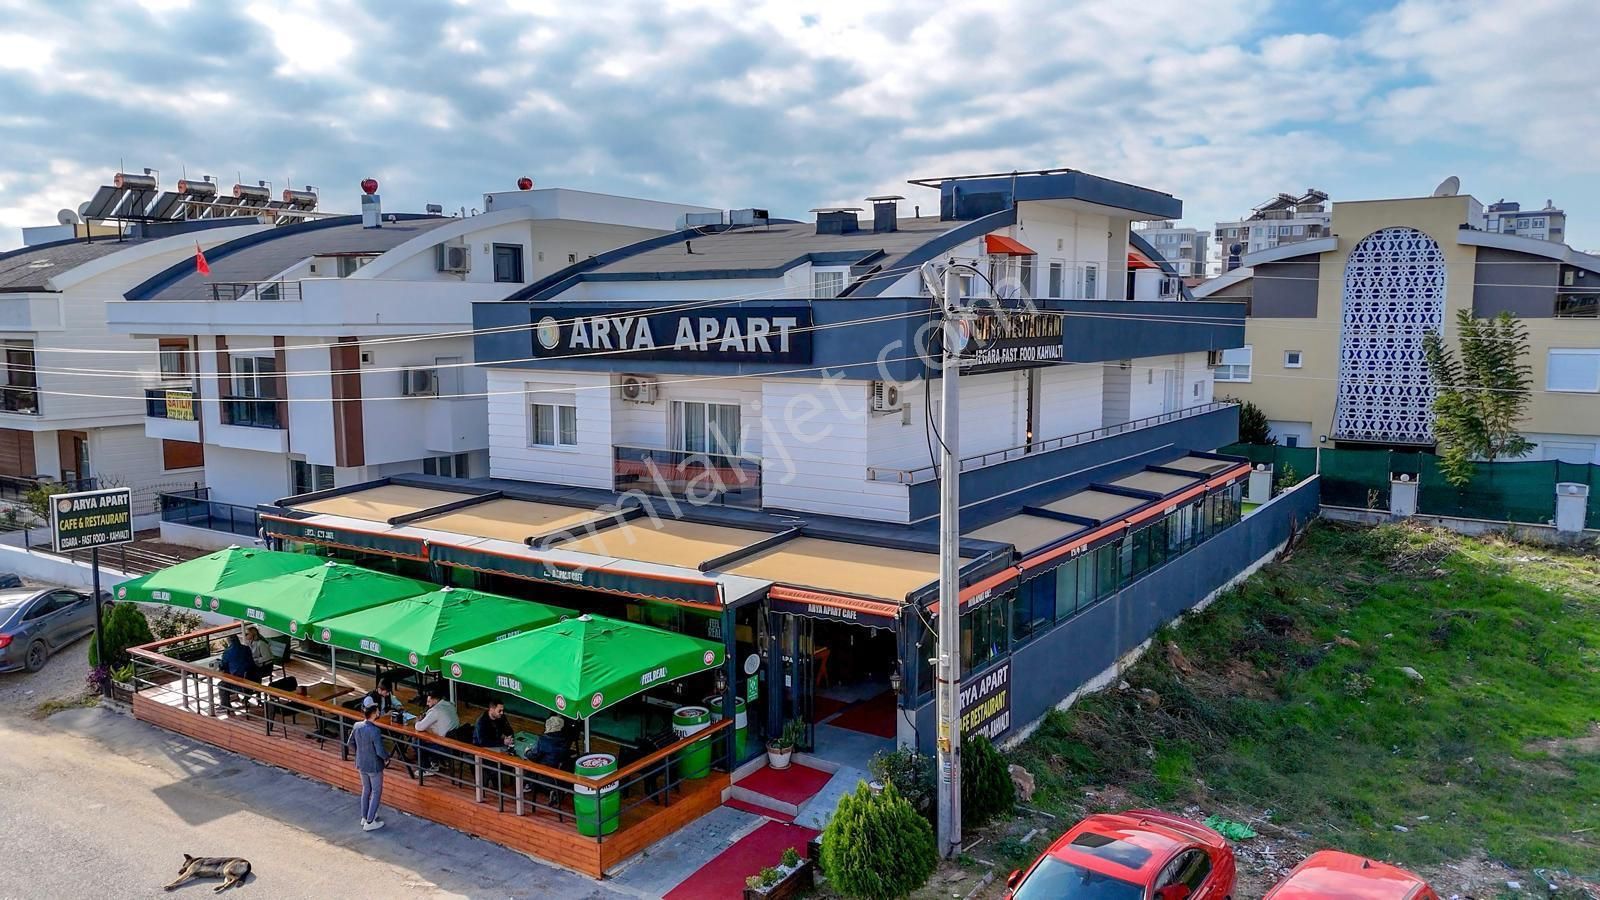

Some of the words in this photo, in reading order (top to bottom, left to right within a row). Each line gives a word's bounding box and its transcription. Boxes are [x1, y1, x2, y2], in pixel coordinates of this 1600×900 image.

[569, 317, 654, 350] ARYA
[673, 317, 797, 353] APART
[1002, 347, 1018, 364] FAST
[1019, 346, 1035, 361] FOOD
[1037, 345, 1063, 359] KAHVALTI
[73, 497, 97, 511] ARYA
[100, 494, 128, 507] APART
[60, 517, 77, 531] CAFE
[79, 517, 84, 529] &
[85, 512, 128, 527] RESTAURANT
[82, 534, 92, 545] FAST
[93, 533, 105, 543] FOOD
[808, 603, 822, 614] ARYA
[823, 605, 841, 617] APART
[842, 609, 857, 620] CAFE
[960, 685, 977, 709] RYA
[979, 665, 1008, 698] APART
[970, 690, 1006, 729] RESTAURANT
